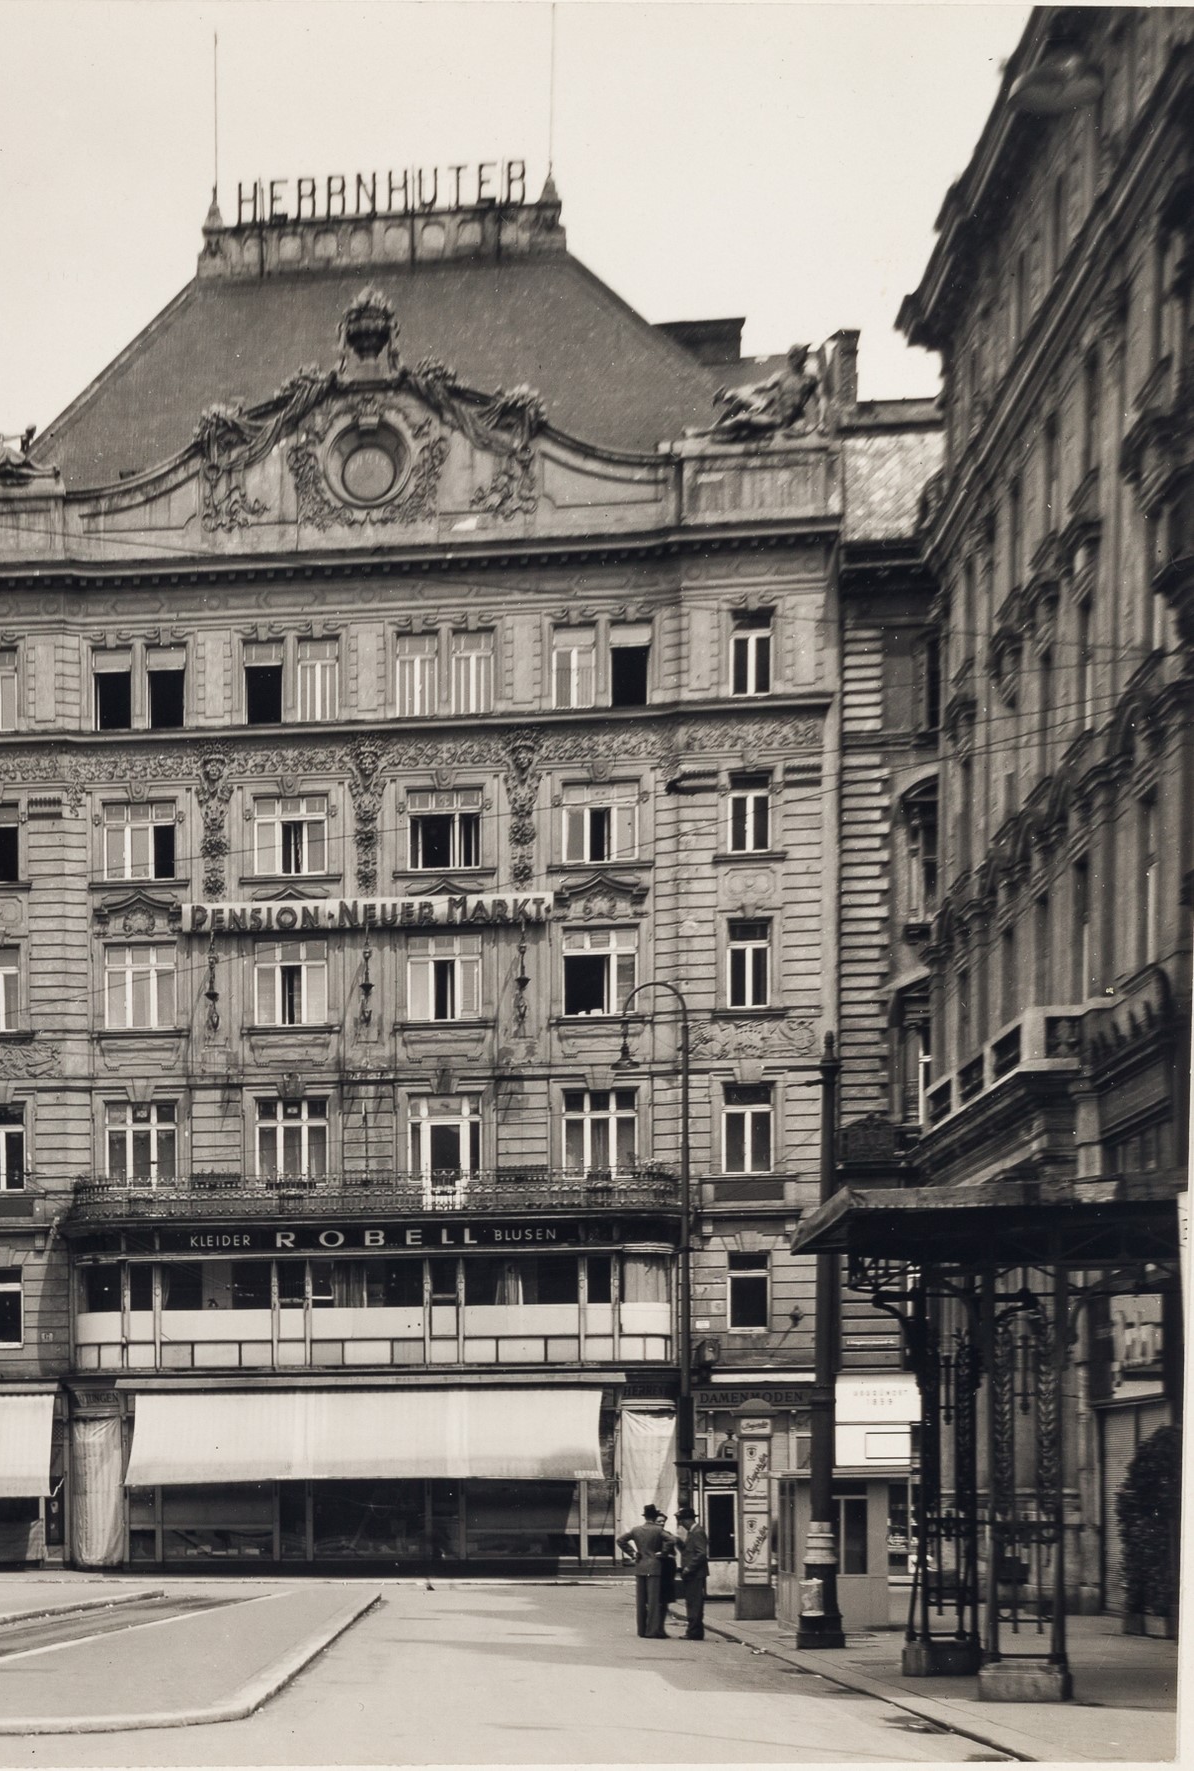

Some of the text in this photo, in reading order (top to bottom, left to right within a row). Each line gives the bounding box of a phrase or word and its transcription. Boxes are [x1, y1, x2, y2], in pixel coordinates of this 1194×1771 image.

[237, 160, 526, 226] HERRNHUTER
[190, 895, 546, 931] PENSION NEUER MARKT
[190, 1228, 557, 1248] KLEIDER ROBELL BLUSEN
[700, 1391, 804, 1404] DAMENMODEN
